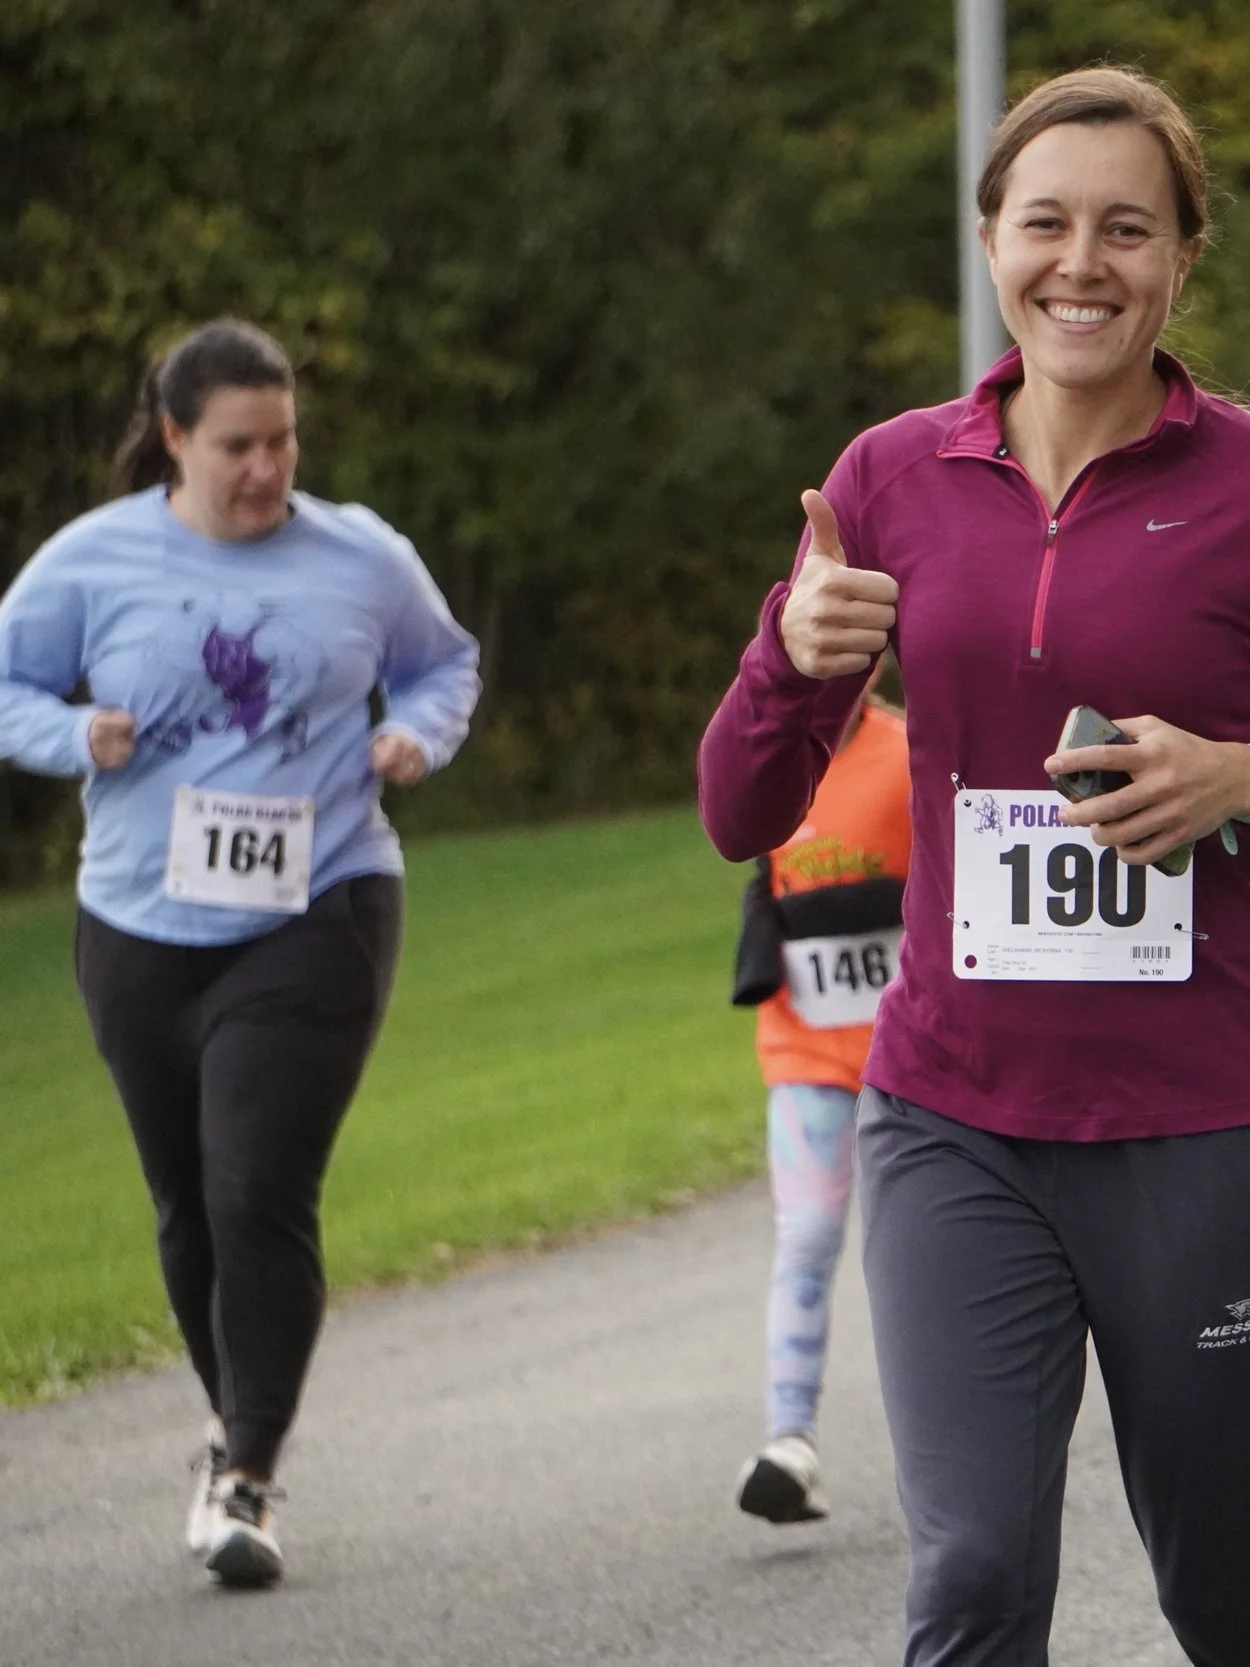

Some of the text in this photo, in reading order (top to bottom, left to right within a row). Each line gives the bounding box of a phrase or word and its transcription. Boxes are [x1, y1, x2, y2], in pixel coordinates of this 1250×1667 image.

[1009, 804, 1069, 828] POLA
[204, 825, 287, 879] 164
[999, 843, 1147, 928] 190
[808, 941, 890, 994] 146
[1197, 1339, 1237, 1349] TRACK
